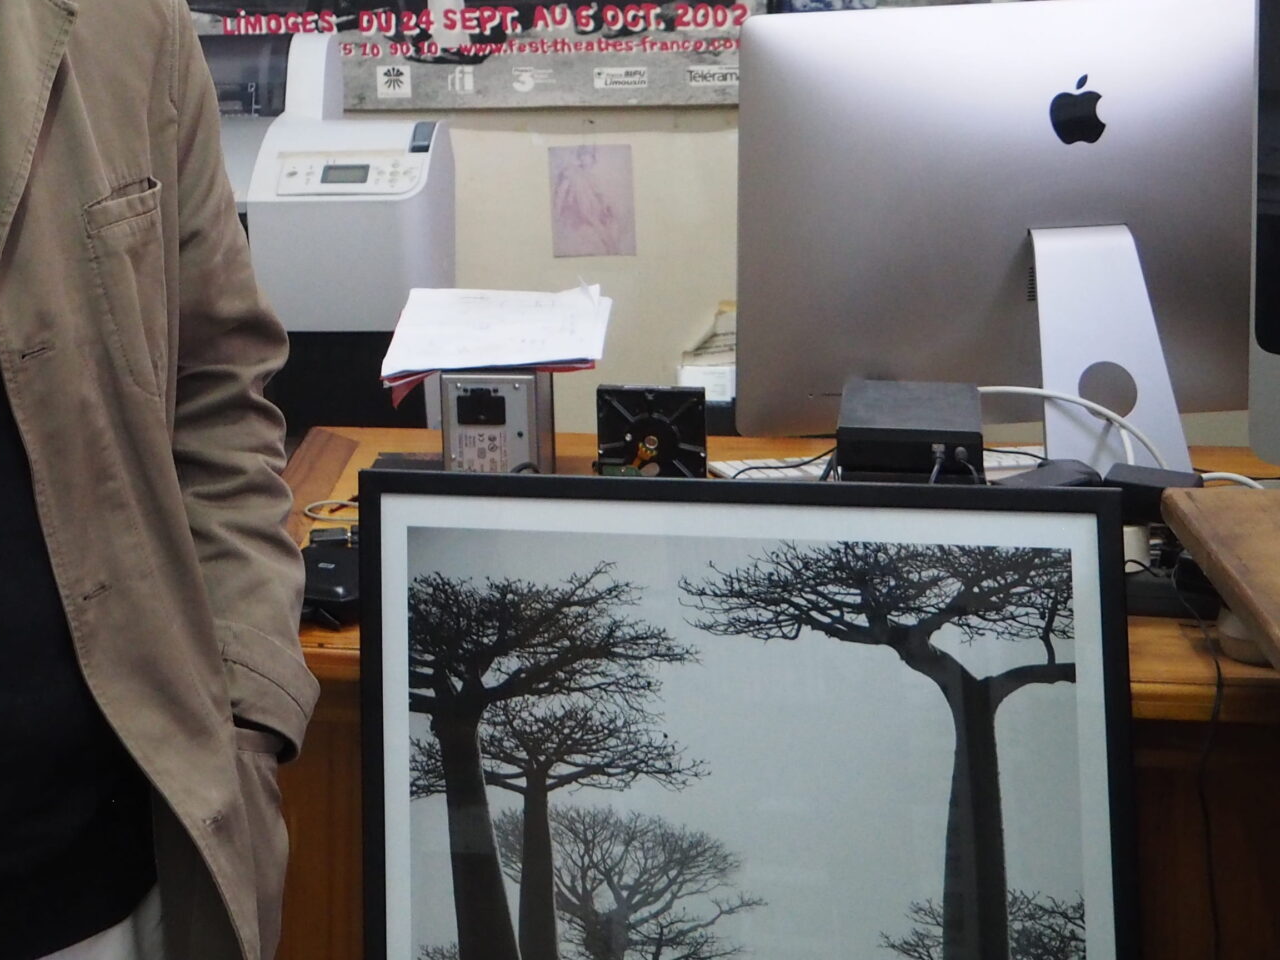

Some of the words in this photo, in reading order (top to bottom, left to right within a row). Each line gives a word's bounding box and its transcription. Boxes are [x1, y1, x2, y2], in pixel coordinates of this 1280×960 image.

[222, 8, 338, 37] LIMOGES
[357, 9, 397, 36] DU
[399, 7, 437, 35] 24
[442, 5, 521, 35] SEPT.
[532, 4, 571, 32] AU
[575, 4, 596, 31] 6
[601, 2, 666, 31] OCT.
[673, 2, 749, 30] 2002
[360, 42, 382, 58] 10
[389, 41, 412, 57] 90
[418, 41, 439, 56] 10
